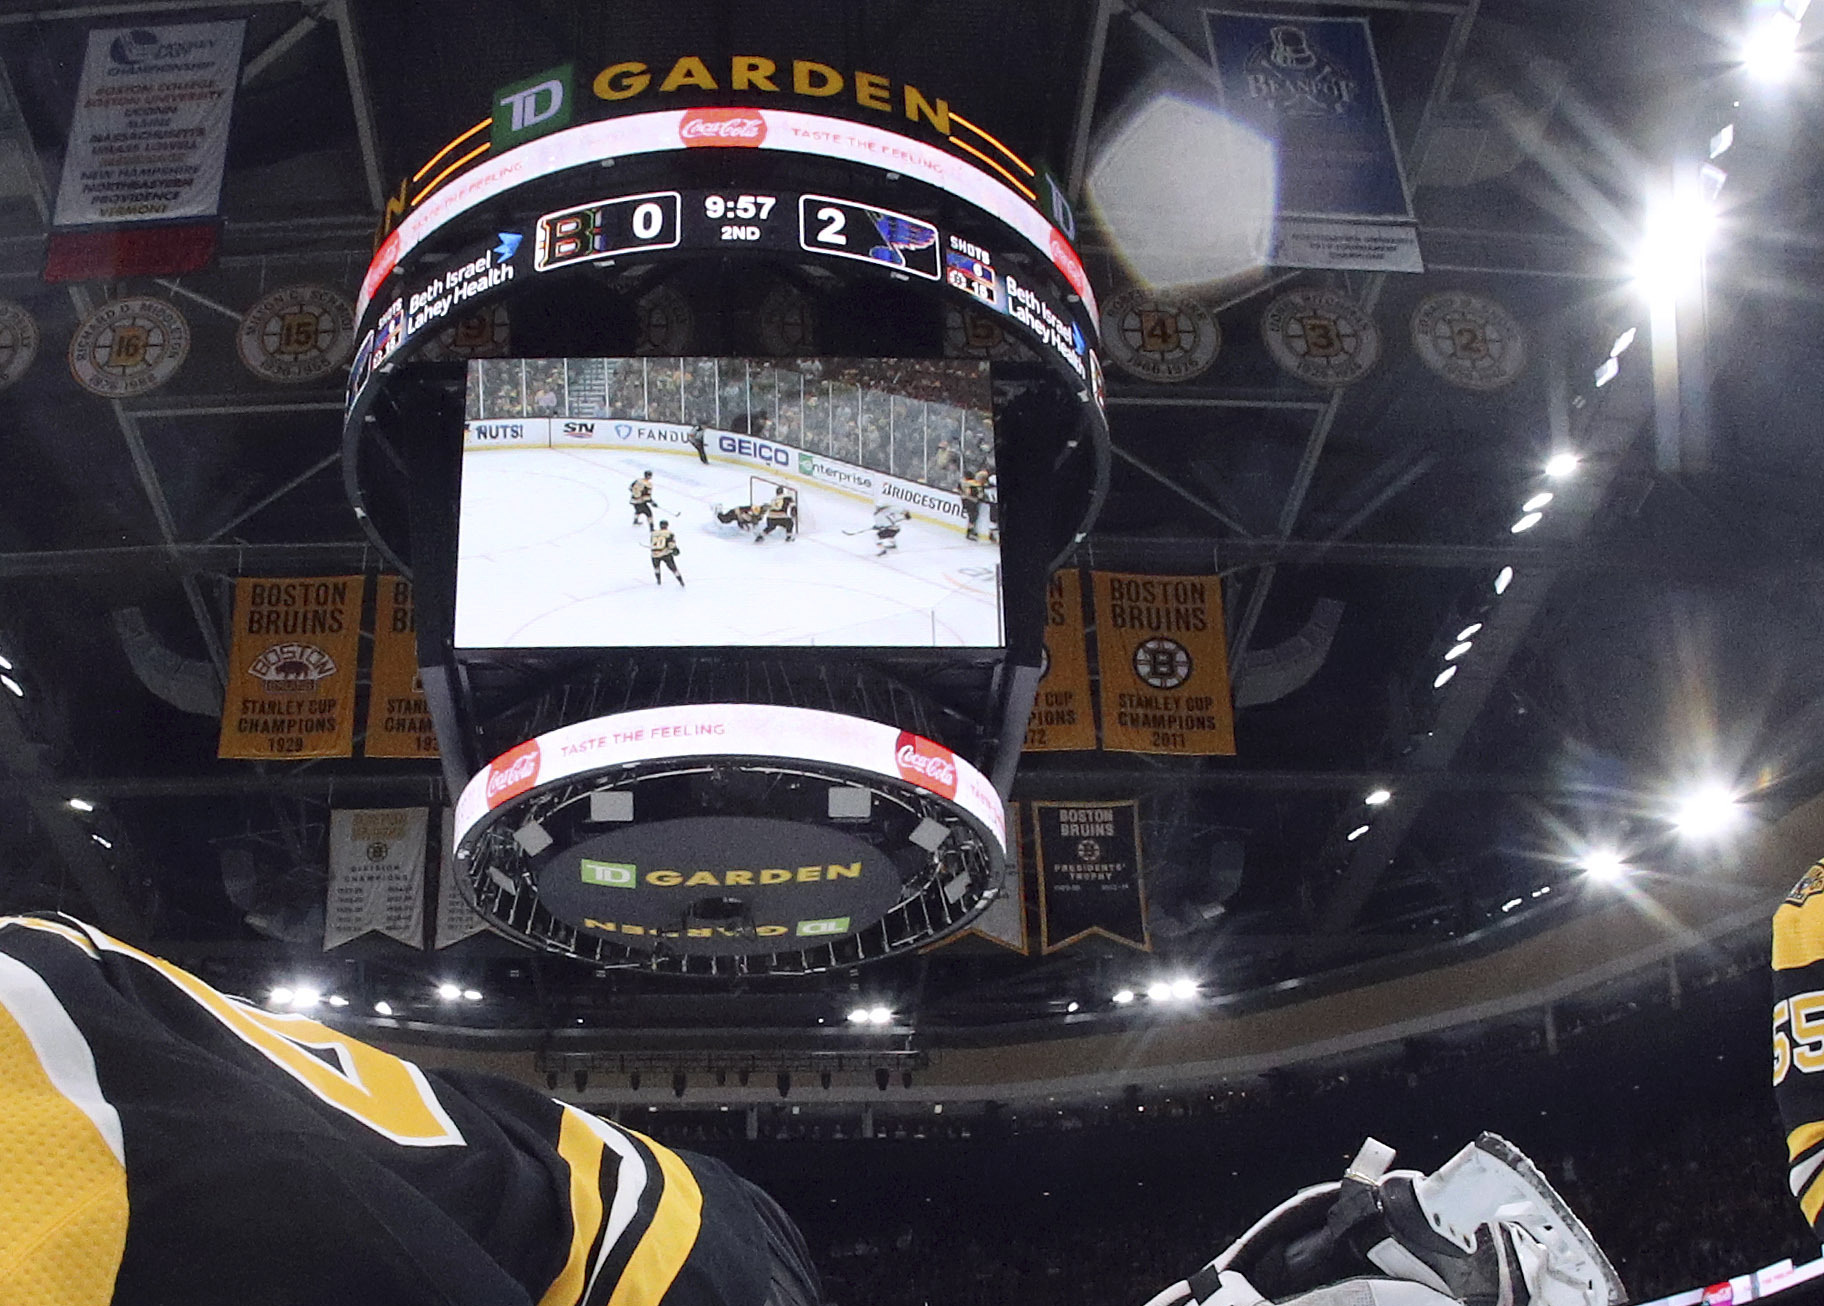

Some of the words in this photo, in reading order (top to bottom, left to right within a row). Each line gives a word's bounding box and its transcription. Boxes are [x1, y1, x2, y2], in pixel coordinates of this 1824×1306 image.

[500, 79, 564, 132] TD
[593, 56, 950, 136] GARDEN
[681, 115, 761, 139] Coca-Cola
[790, 127, 843, 145] TASTE
[847, 138, 878, 153] THE
[881, 146, 944, 175] FEELING
[705, 196, 777, 219] 9:57
[631, 203, 664, 240] 0
[720, 225, 761, 241] 2ND
[816, 208, 847, 245] 2
[949, 234, 991, 266] SHOTS
[409, 279, 444, 315] Beth
[445, 249, 492, 291] Israel
[407, 295, 452, 336] Lahey
[453, 263, 514, 305] Health
[1006, 275, 1041, 316] Beth
[1041, 301, 1073, 347] Israel
[285, 322, 314, 347] 15
[1008, 296, 1050, 346] Lahey
[1050, 331, 1087, 381] Health
[1147, 318, 1173, 346] 4
[1311, 321, 1336, 351] 3
[477, 424, 523, 440] NUTS!
[638, 428, 690, 444] FANDU
[719, 435, 790, 466] GEICO
[251, 581, 347, 608] BOSTON
[1110, 578, 1206, 604] BOSTON
[248, 608, 344, 635] BRUINS
[1111, 602, 1208, 632] BRUINS
[253, 644, 334, 677] BOSTON
[241, 699, 303, 716] STANLEY
[308, 699, 337, 714] CUP
[1045, 691, 1074, 707] CUP
[1119, 693, 1181, 712] STANLEY
[1186, 696, 1214, 712] CUP
[238, 717, 337, 734] CHAMPIONS
[1118, 711, 1217, 732] CHAMPIONS
[267, 735, 304, 753] 1929
[560, 737, 607, 756] TASTE
[612, 730, 645, 744] THE
[650, 723, 725, 740] FEELING
[1152, 731, 1186, 748] 2011
[487, 753, 538, 796] Coca-Cola
[897, 744, 954, 784] Coca-Cola
[1059, 808, 1114, 824] BOSTON
[1060, 823, 1115, 837] BRUINS
[585, 865, 632, 886] TD
[645, 861, 863, 888] GARDEN
